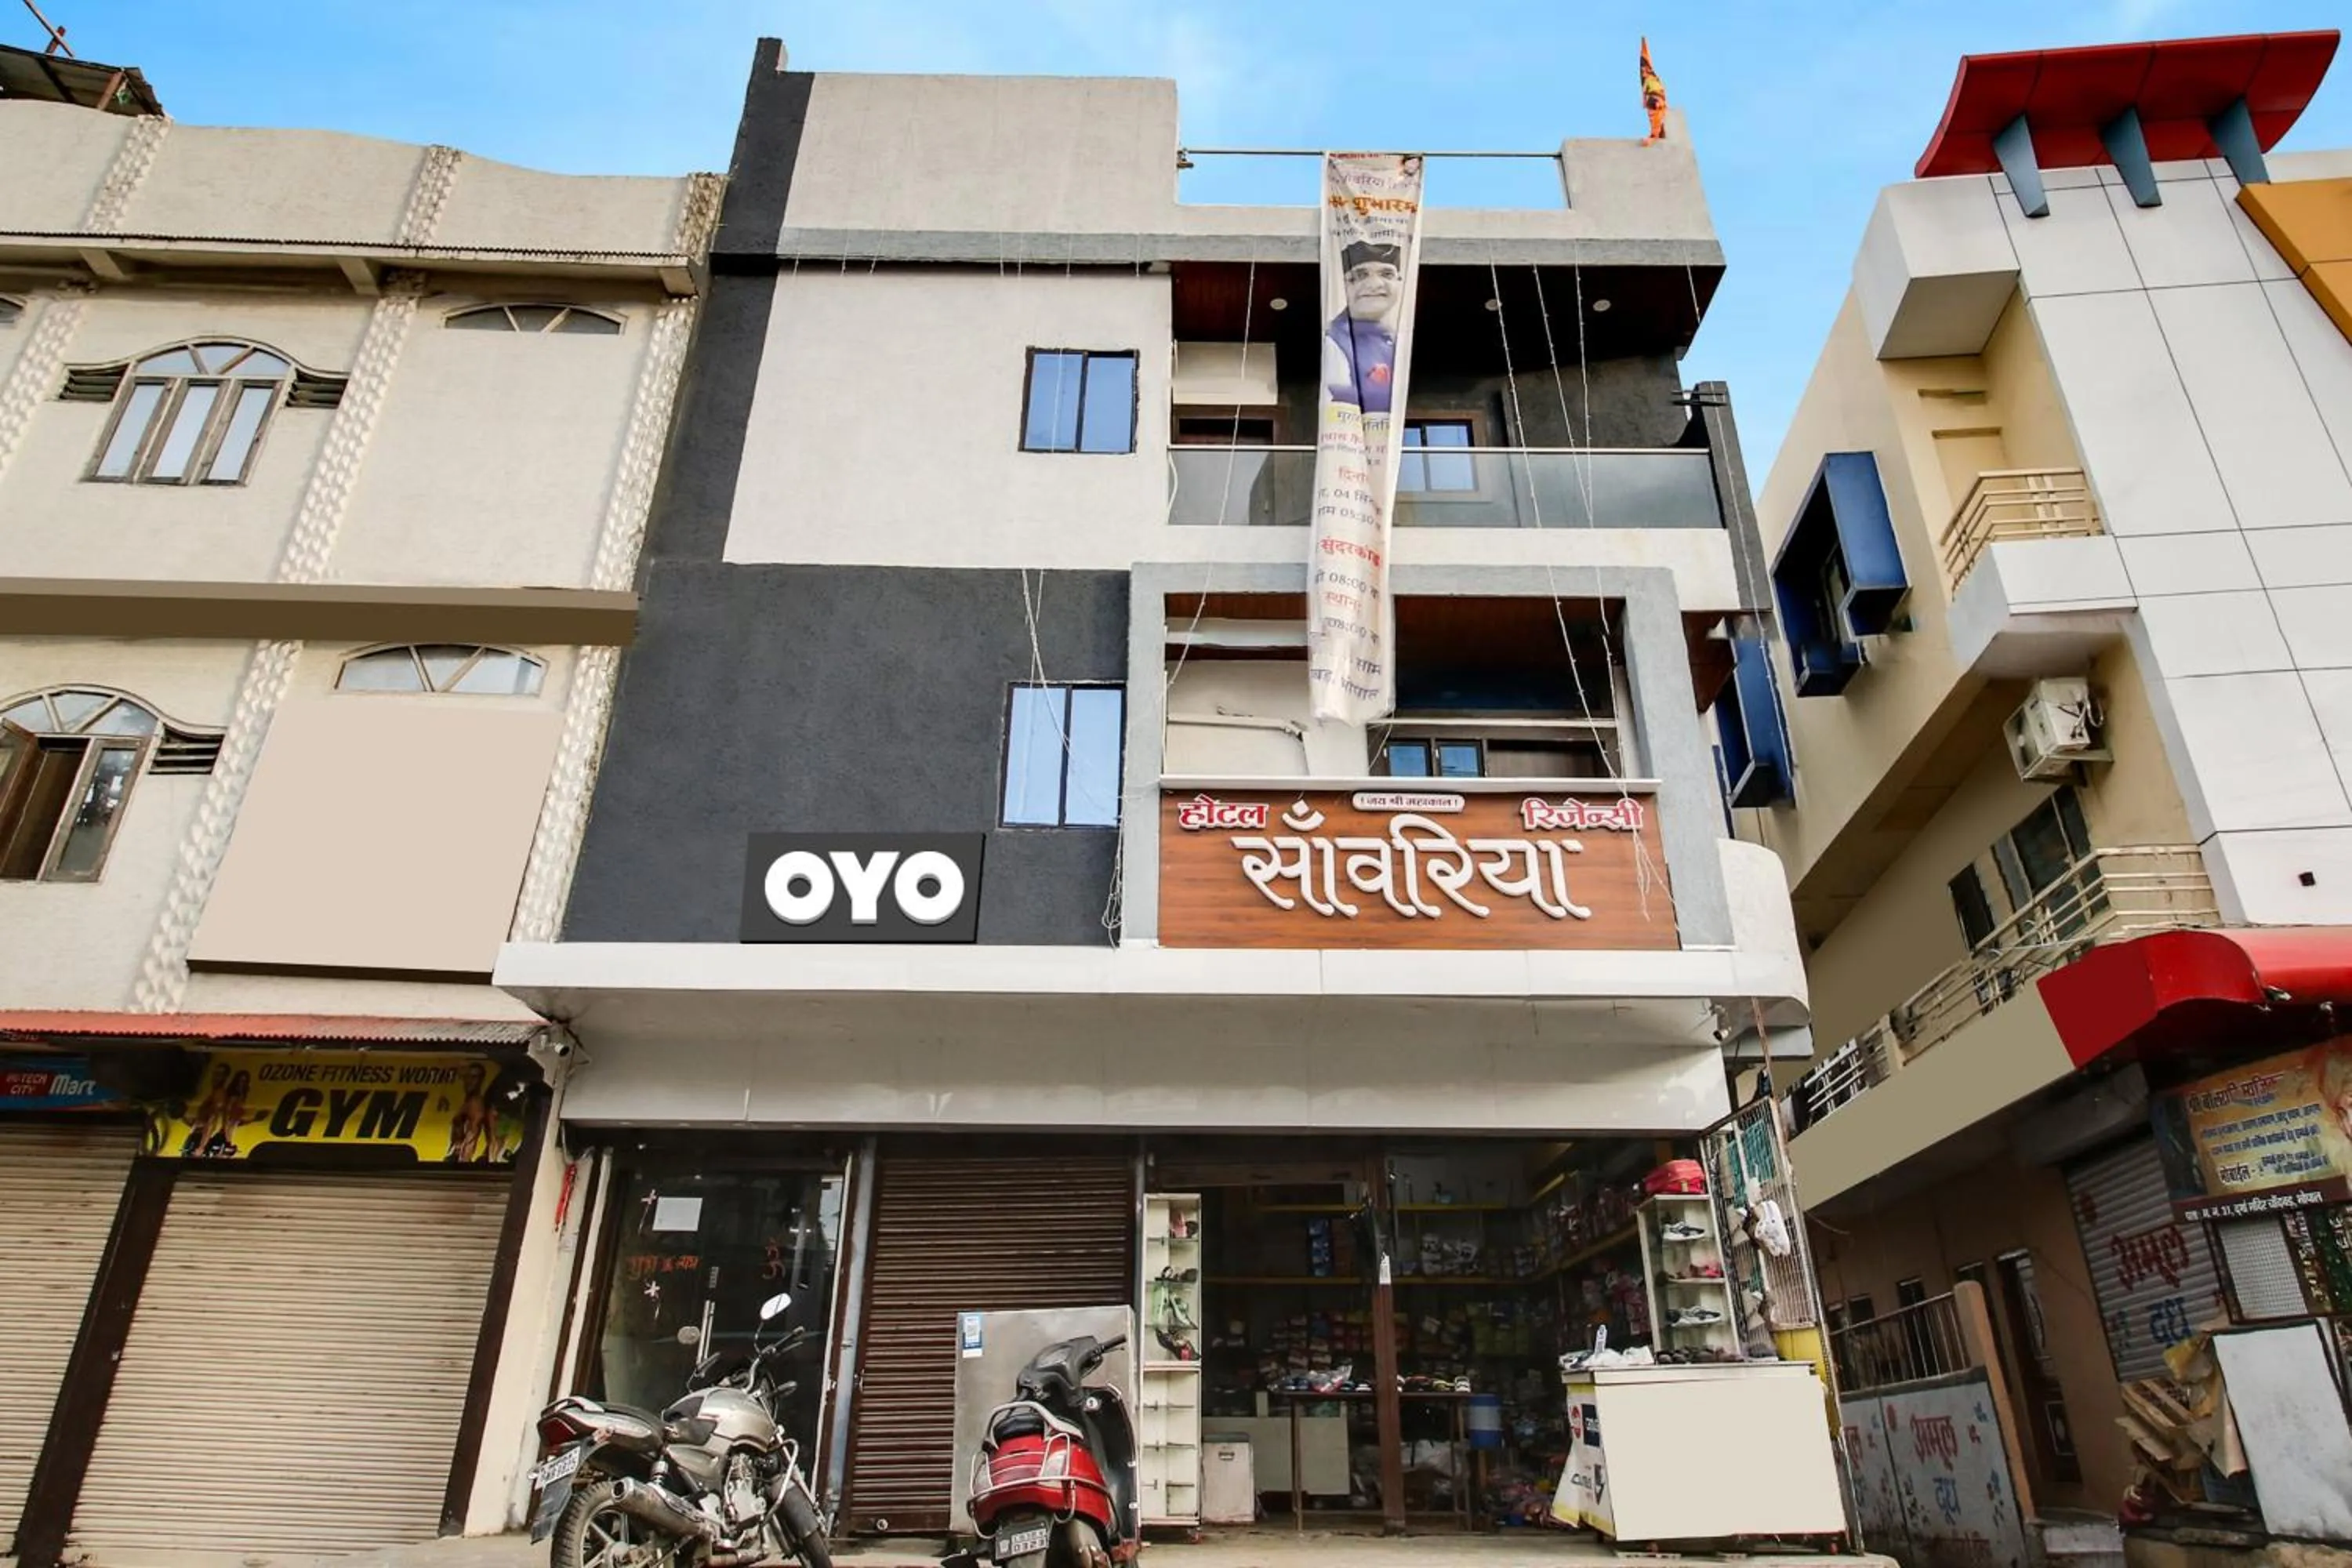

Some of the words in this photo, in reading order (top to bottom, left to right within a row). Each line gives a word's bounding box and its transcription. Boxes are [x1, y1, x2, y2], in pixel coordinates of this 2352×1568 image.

[1178, 793, 1269, 828] होटल
[764, 851, 964, 926] OYO
[49, 1074, 96, 1095] Mart
[259, 1063, 314, 1081] OZONE
[318, 1065, 394, 1083] FITNESS
[269, 1087, 430, 1138] GYM
[1909, 1414, 1958, 1472] अमूल
